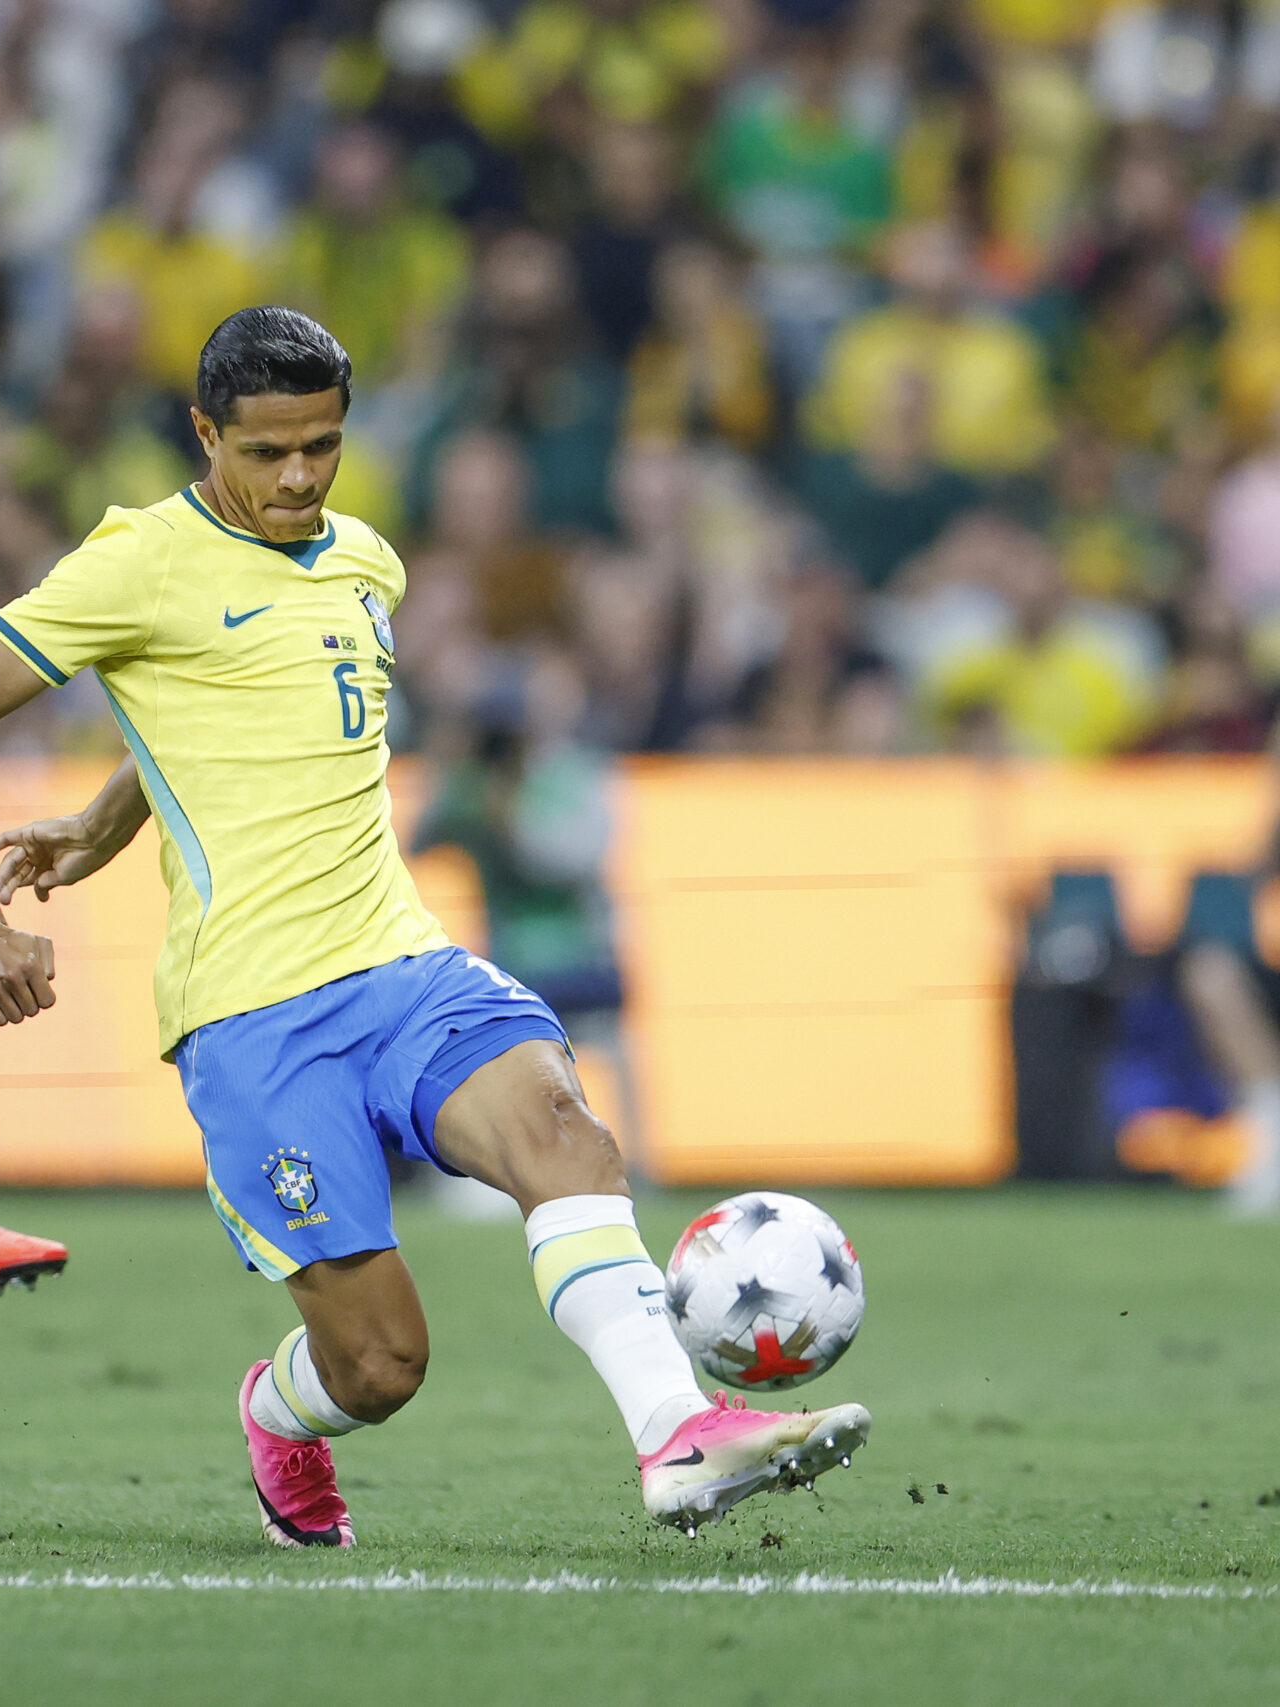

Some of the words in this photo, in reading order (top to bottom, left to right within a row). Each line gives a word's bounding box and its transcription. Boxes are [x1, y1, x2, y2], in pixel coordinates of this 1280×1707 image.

[332, 661, 366, 739] 6
[284, 1178, 302, 1190] CBF
[285, 1211, 331, 1231] BRASIL
